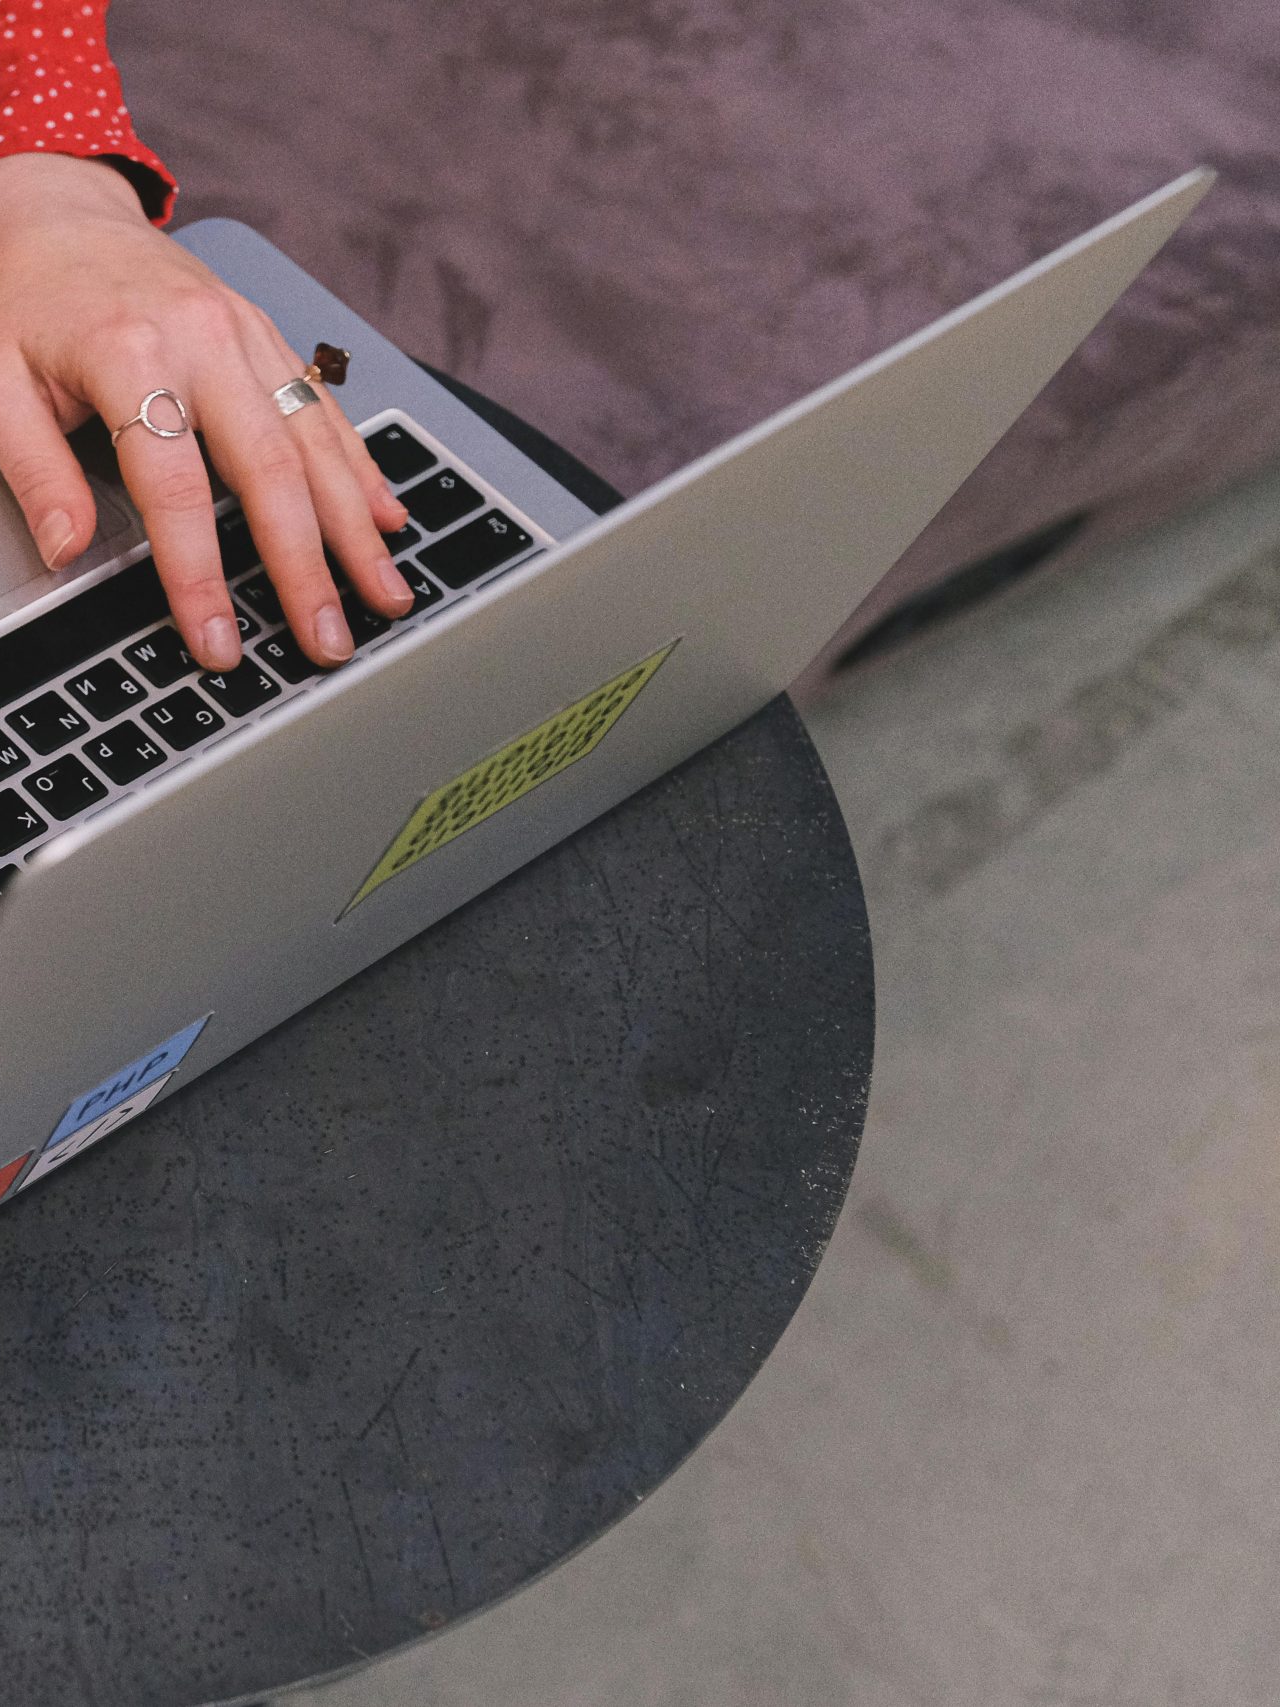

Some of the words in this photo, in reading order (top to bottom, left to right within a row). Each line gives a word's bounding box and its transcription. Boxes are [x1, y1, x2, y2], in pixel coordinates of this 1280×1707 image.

[414, 580, 431, 595] A
[75, 679, 97, 696] И
[120, 679, 139, 695] B
[259, 675, 272, 690] F
[58, 712, 80, 730] N
[152, 707, 174, 724] П
[195, 710, 214, 725] G
[136, 742, 158, 760] H
[81, 776, 94, 792] J
[16, 811, 38, 829] K
[77, 1052, 169, 1121] PHP
